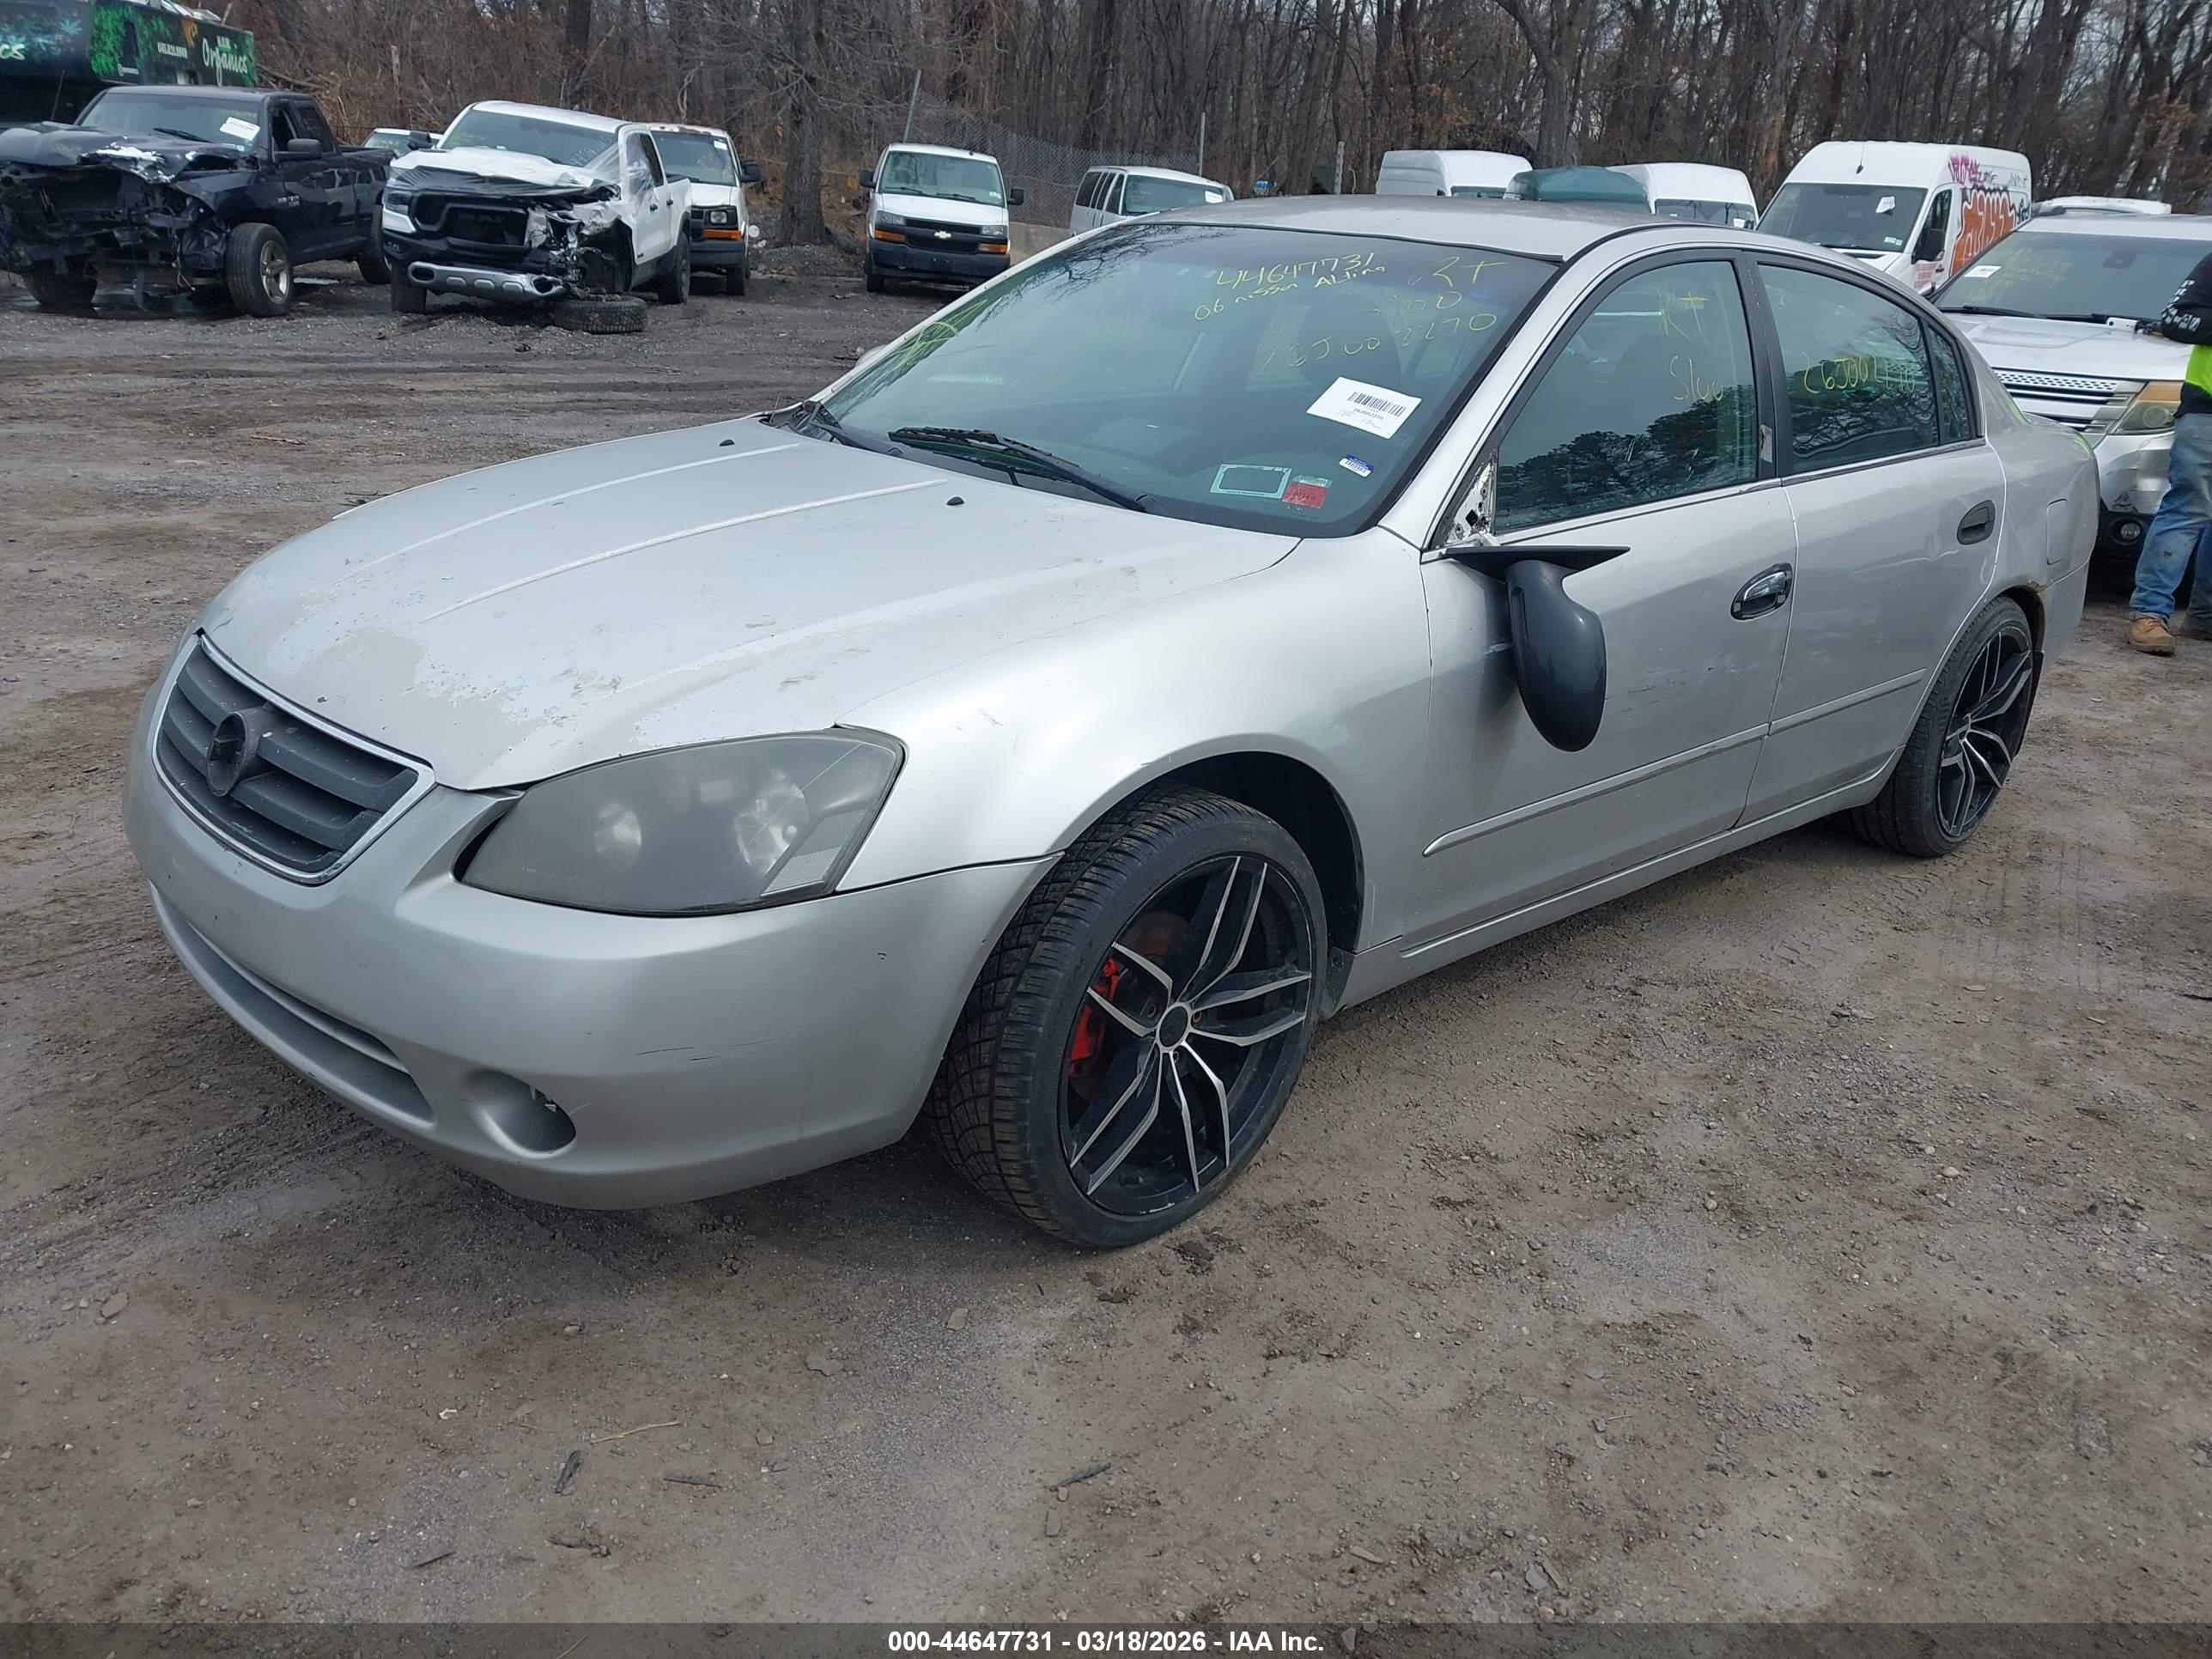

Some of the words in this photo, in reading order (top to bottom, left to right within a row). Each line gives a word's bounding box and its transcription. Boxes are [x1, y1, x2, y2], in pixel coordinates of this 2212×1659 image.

[202, 37, 249, 87] Organics
[1215, 252, 1375, 289] 44647731
[1194, 298, 1224, 320] 06
